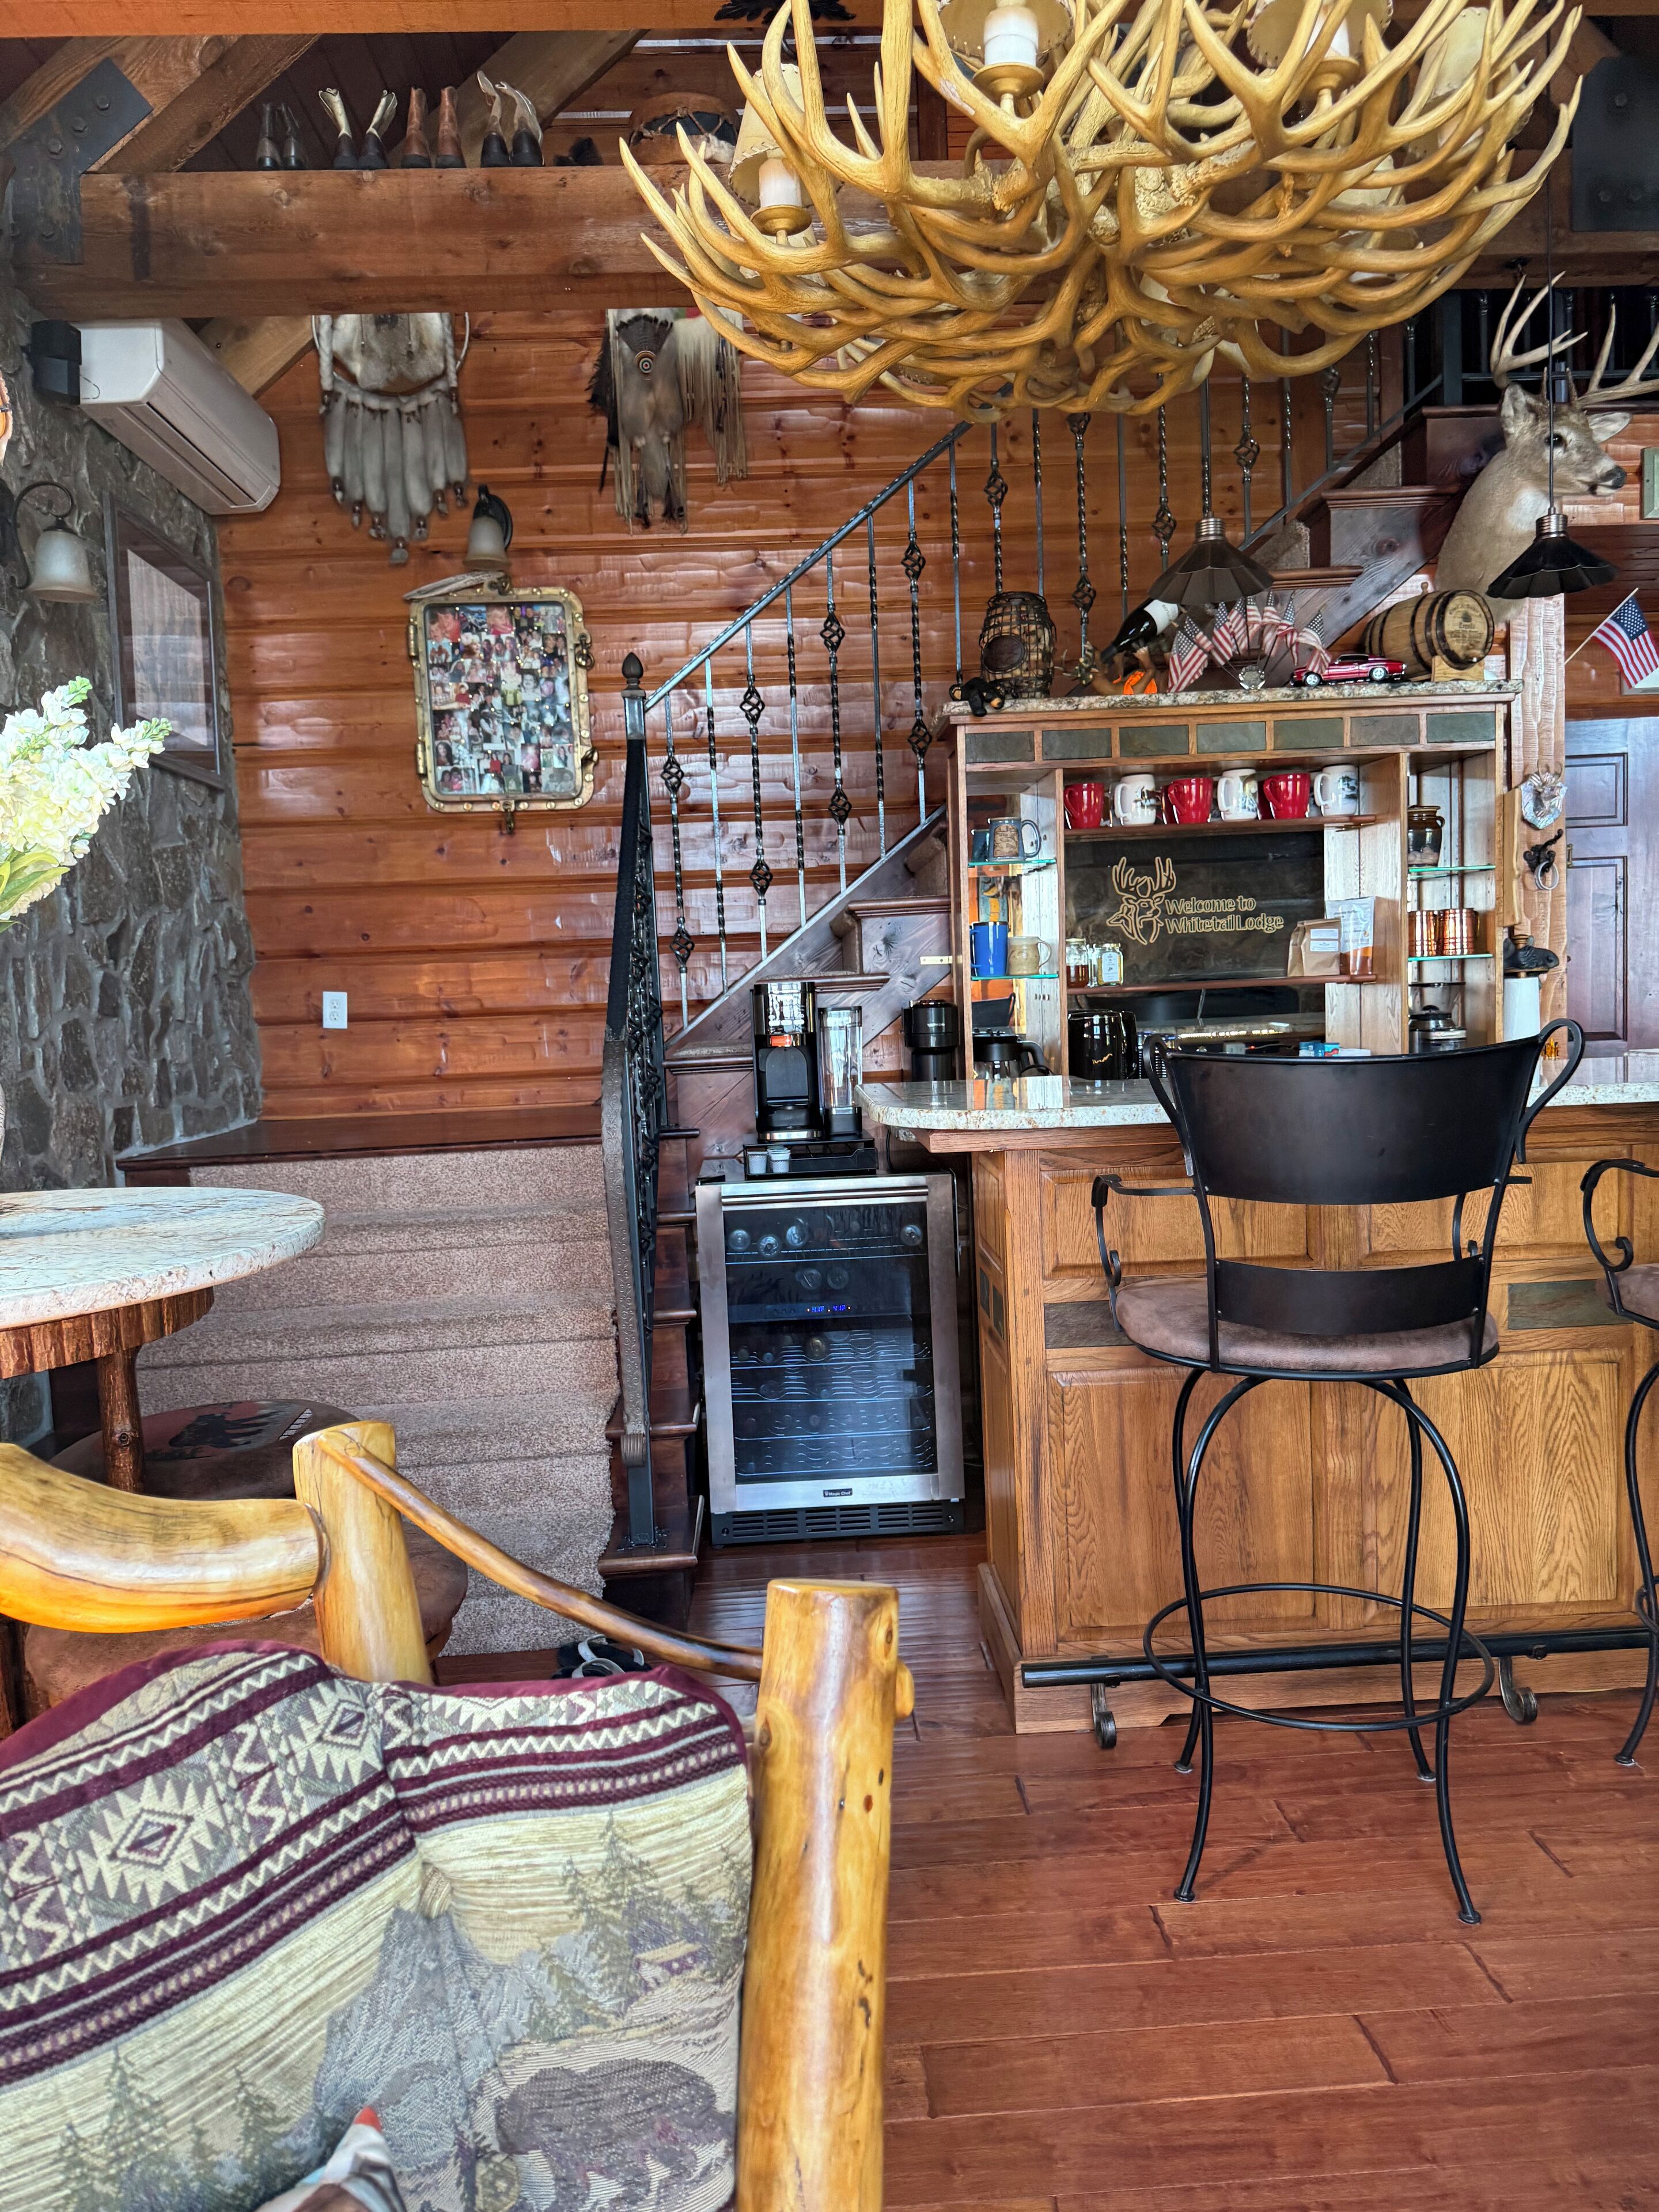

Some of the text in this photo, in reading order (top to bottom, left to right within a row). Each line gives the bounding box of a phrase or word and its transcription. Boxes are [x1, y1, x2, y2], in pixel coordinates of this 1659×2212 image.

[1165, 895, 1256, 915] Welcome to
[1165, 913, 1284, 934] Whitetail Lodge
